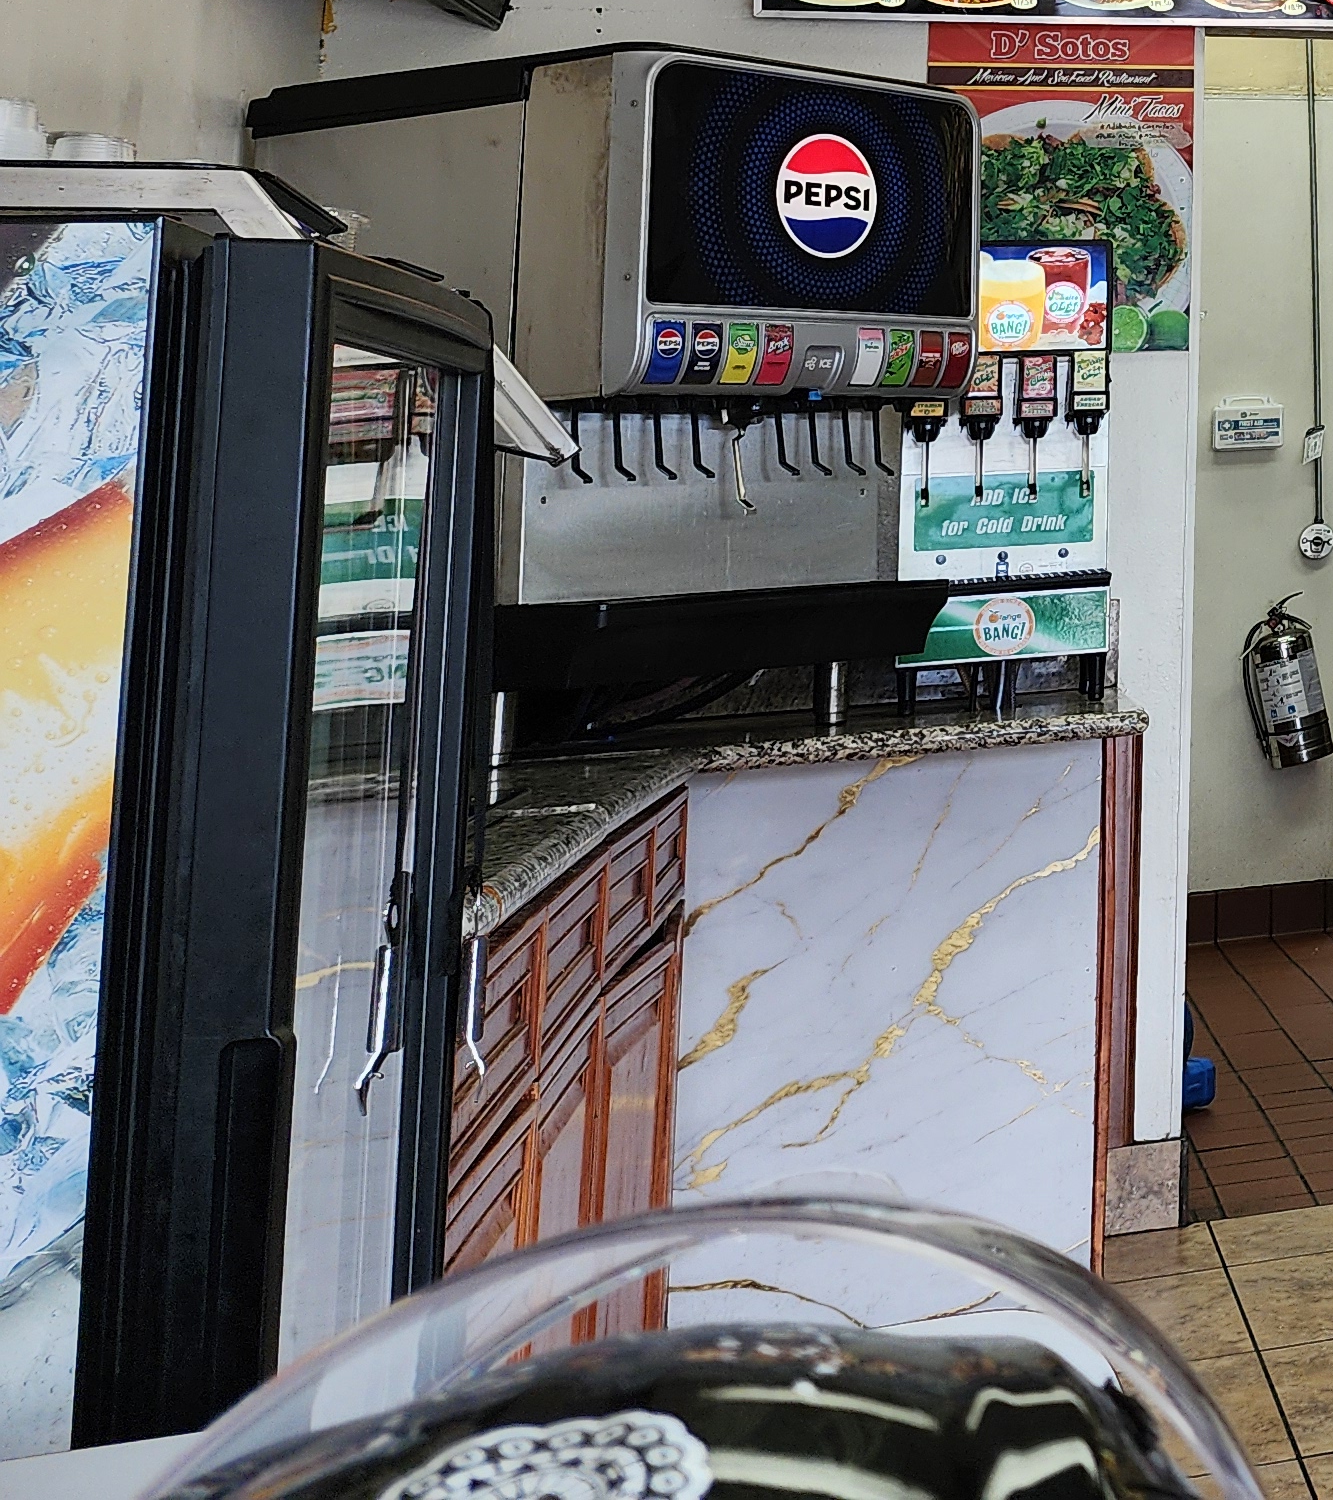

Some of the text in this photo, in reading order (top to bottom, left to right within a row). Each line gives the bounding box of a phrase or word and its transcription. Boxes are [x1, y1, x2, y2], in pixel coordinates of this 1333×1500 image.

[1034, 31, 1130, 61] Sotos
[966, 68, 1014, 85] Mexican
[1016, 68, 1048, 85] And
[1082, 94, 1184, 121] Mini Tacos
[784, 179, 871, 211] PEPSI
[658, 338, 681, 348] PEPSI
[695, 339, 719, 350] PEPSI
[818, 358, 832, 368] ICE
[941, 513, 1068, 537] for Cold Drink
[983, 621, 1026, 642] BANG!
